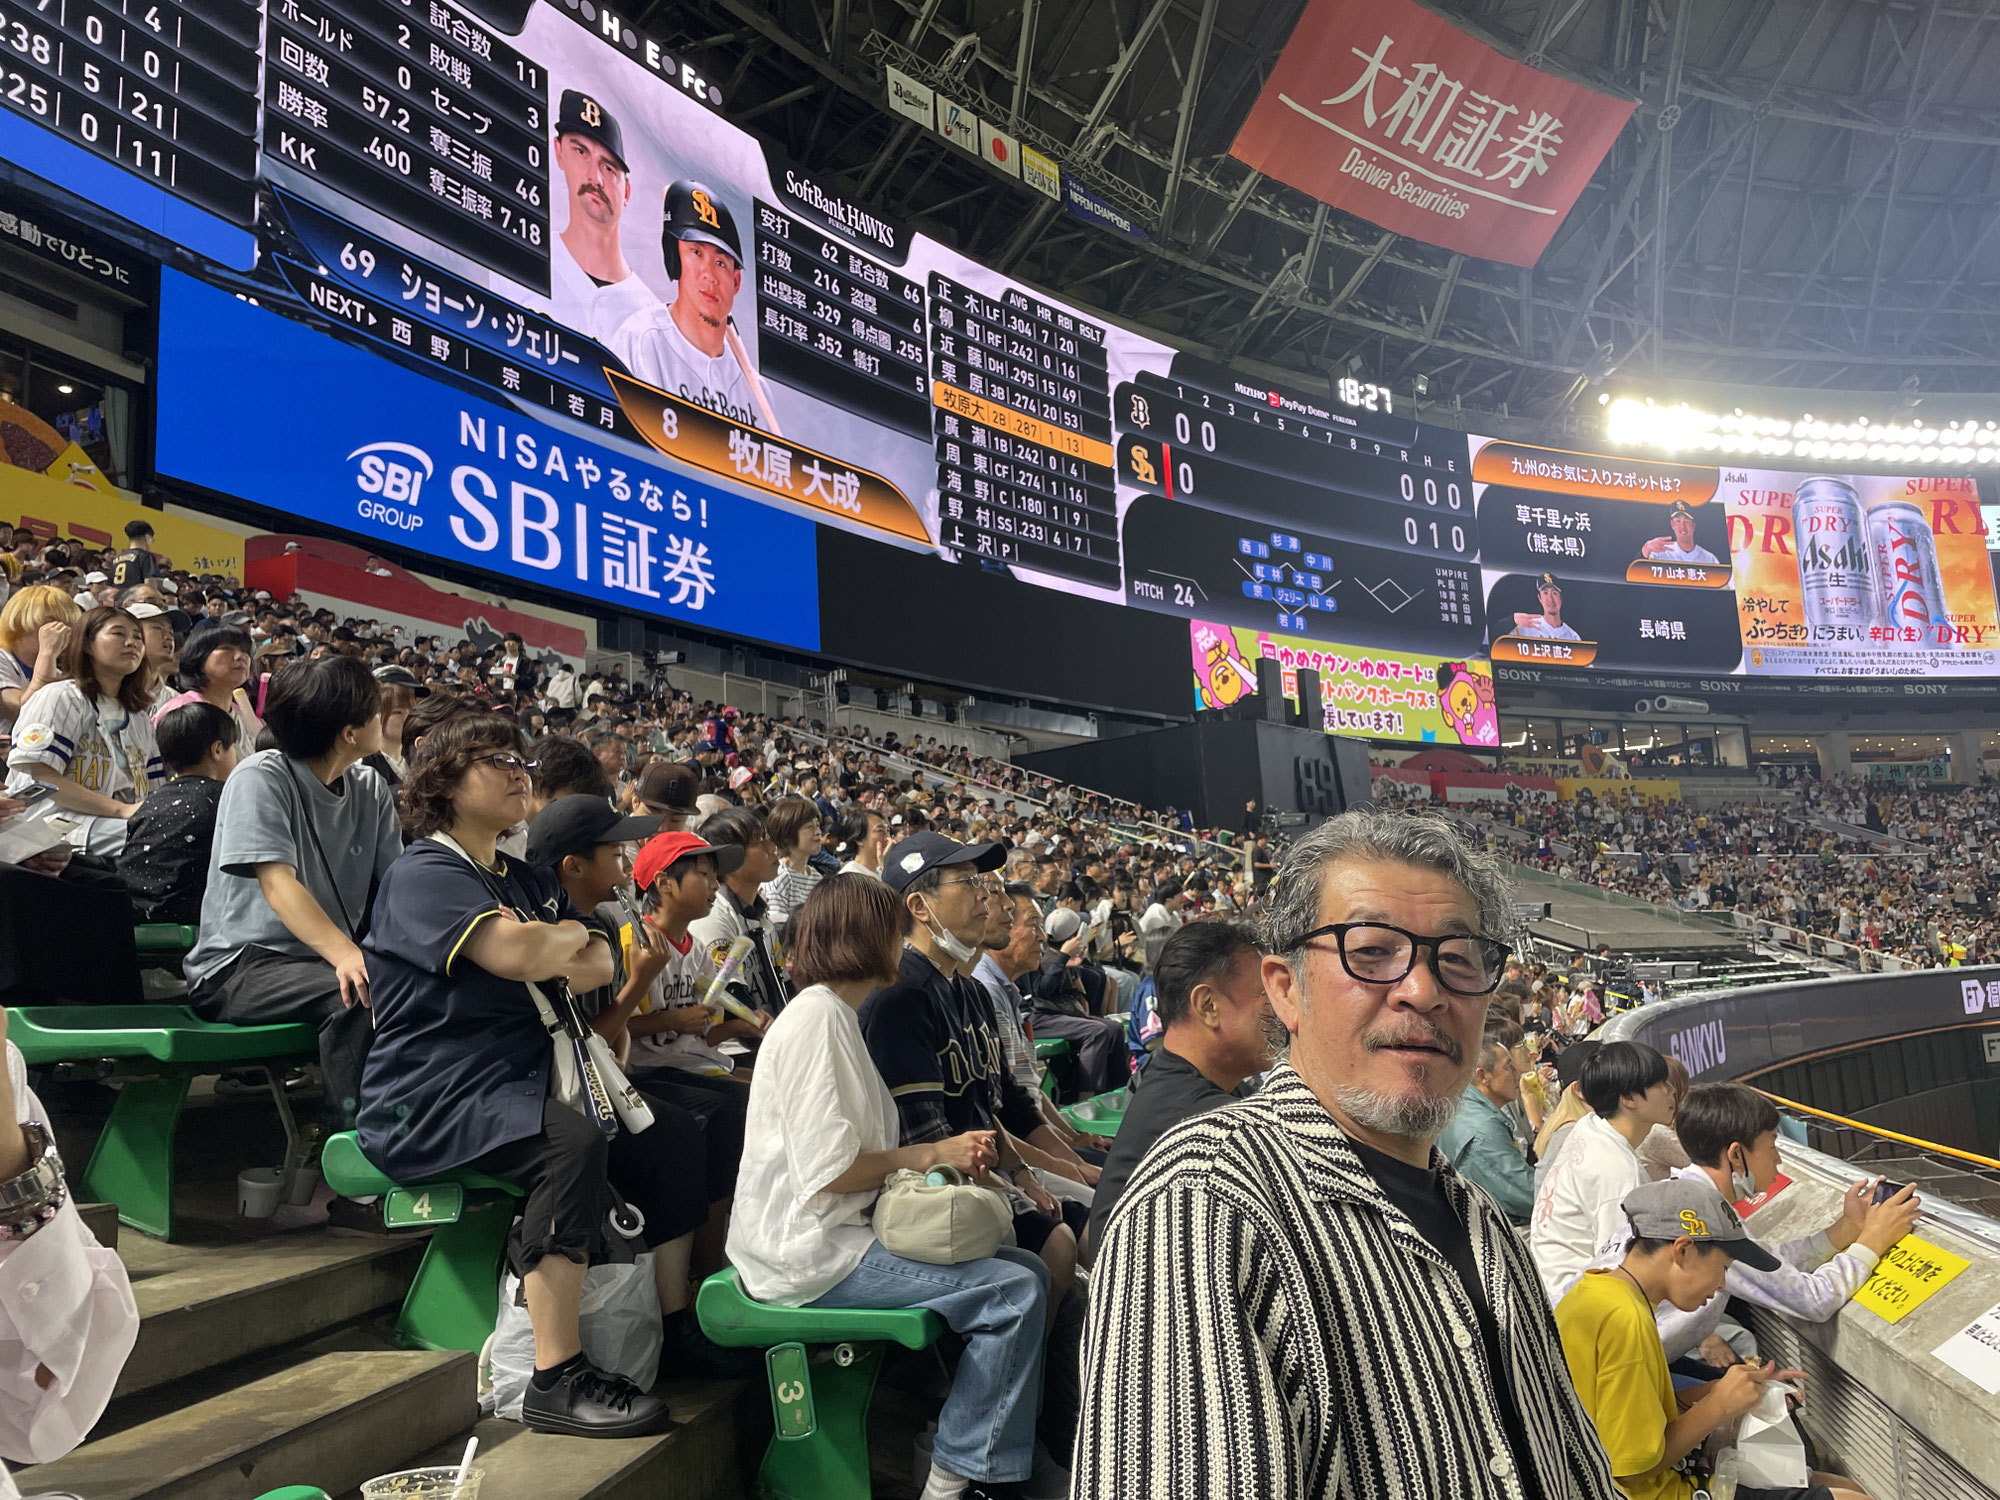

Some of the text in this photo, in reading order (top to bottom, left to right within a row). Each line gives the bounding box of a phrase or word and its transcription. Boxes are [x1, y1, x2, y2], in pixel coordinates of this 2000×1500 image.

[144, 6, 162, 32] 4
[86, 15, 160, 78] 0 0
[430, 1, 537, 89] 試合数 11
[602, 9, 707, 100] H E FC
[84, 62, 163, 130] 5 21
[281, 0, 540, 168] ホールド 0 セーブ 0
[398, 25, 540, 129] 2 敗戦 3
[280, 36, 541, 207] 回数 57.2 奪三振 46
[1321, 34, 1565, 189] 大和証券
[80, 112, 161, 177] 0 11
[278, 81, 541, 246] 勝率 .400 奪三振率 7.18
[280, 131, 317, 171] KK
[1339, 147, 1470, 220] Daiwa Securities
[786, 170, 895, 249] SoftBank HAWKS
[760, 208, 921, 304] 安打 62 試合数 66
[762, 241, 878, 316] 打数 216 盗塁
[339, 242, 580, 366] 69 ショーン・ジェリー
[763, 274, 923, 364] 出塁率 .329 .255
[1009, 293, 1101, 343] AVG HR RBI RSLT
[310, 281, 365, 324] NEXT
[502, 366, 521, 392] 宗
[764, 307, 843, 359] 長打率 .352
[986, 305, 1000, 322] LF
[1059, 338, 1074, 355] 20
[987, 332, 1002, 348] RF
[1062, 362, 1075, 379] 16
[988, 359, 1004, 376] DH
[1042, 379, 1056, 396] 15
[1062, 387, 1077, 404] 49
[1339, 377, 1392, 414] 18:27
[990, 383, 1006, 400] 3B
[1042, 404, 1057, 420] 20
[1063, 412, 1079, 428] 53
[1235, 383, 1330, 420] MIZUHO PayPay Dome
[662, 407, 679, 440] 8
[357, 454, 423, 506] SBI
[1178, 462, 1194, 494] 0
[1511, 457, 1682, 493] 九州のお気に入りスポットは?
[1725, 472, 1748, 484] Asahi
[1905, 478, 1972, 496] SUPER
[357, 500, 423, 532] GROUP
[1515, 504, 1592, 532] 草千里ヶ浜
[1815, 506, 1843, 514] SUPER
[449, 464, 716, 611] SBI証券
[1526, 532, 1586, 558] (熊本県)
[1803, 535, 1869, 573] Asahi
[113, 563, 126, 585] 9
[1435, 568, 1468, 580] UMPIRE
[1651, 566, 1664, 578] 77
[1829, 572, 1847, 588] 生
[1880, 544, 1895, 601] SUPER
[1134, 580, 1195, 608] PITCH 24
[1742, 597, 1790, 614] 冷やして
[1639, 619, 1687, 641] 長崎県
[1746, 617, 1809, 641] ぶっちぎり
[1944, 613, 1976, 623] SUPER
[1517, 642, 1529, 656] 10
[1498, 668, 1541, 682] SONY
[1700, 680, 1741, 692] SONY
[1904, 684, 1948, 695] SONY
[1670, 1019, 1726, 1078] SANKYU
[413, 1192, 430, 1218] 4
[778, 1380, 804, 1404] 3
